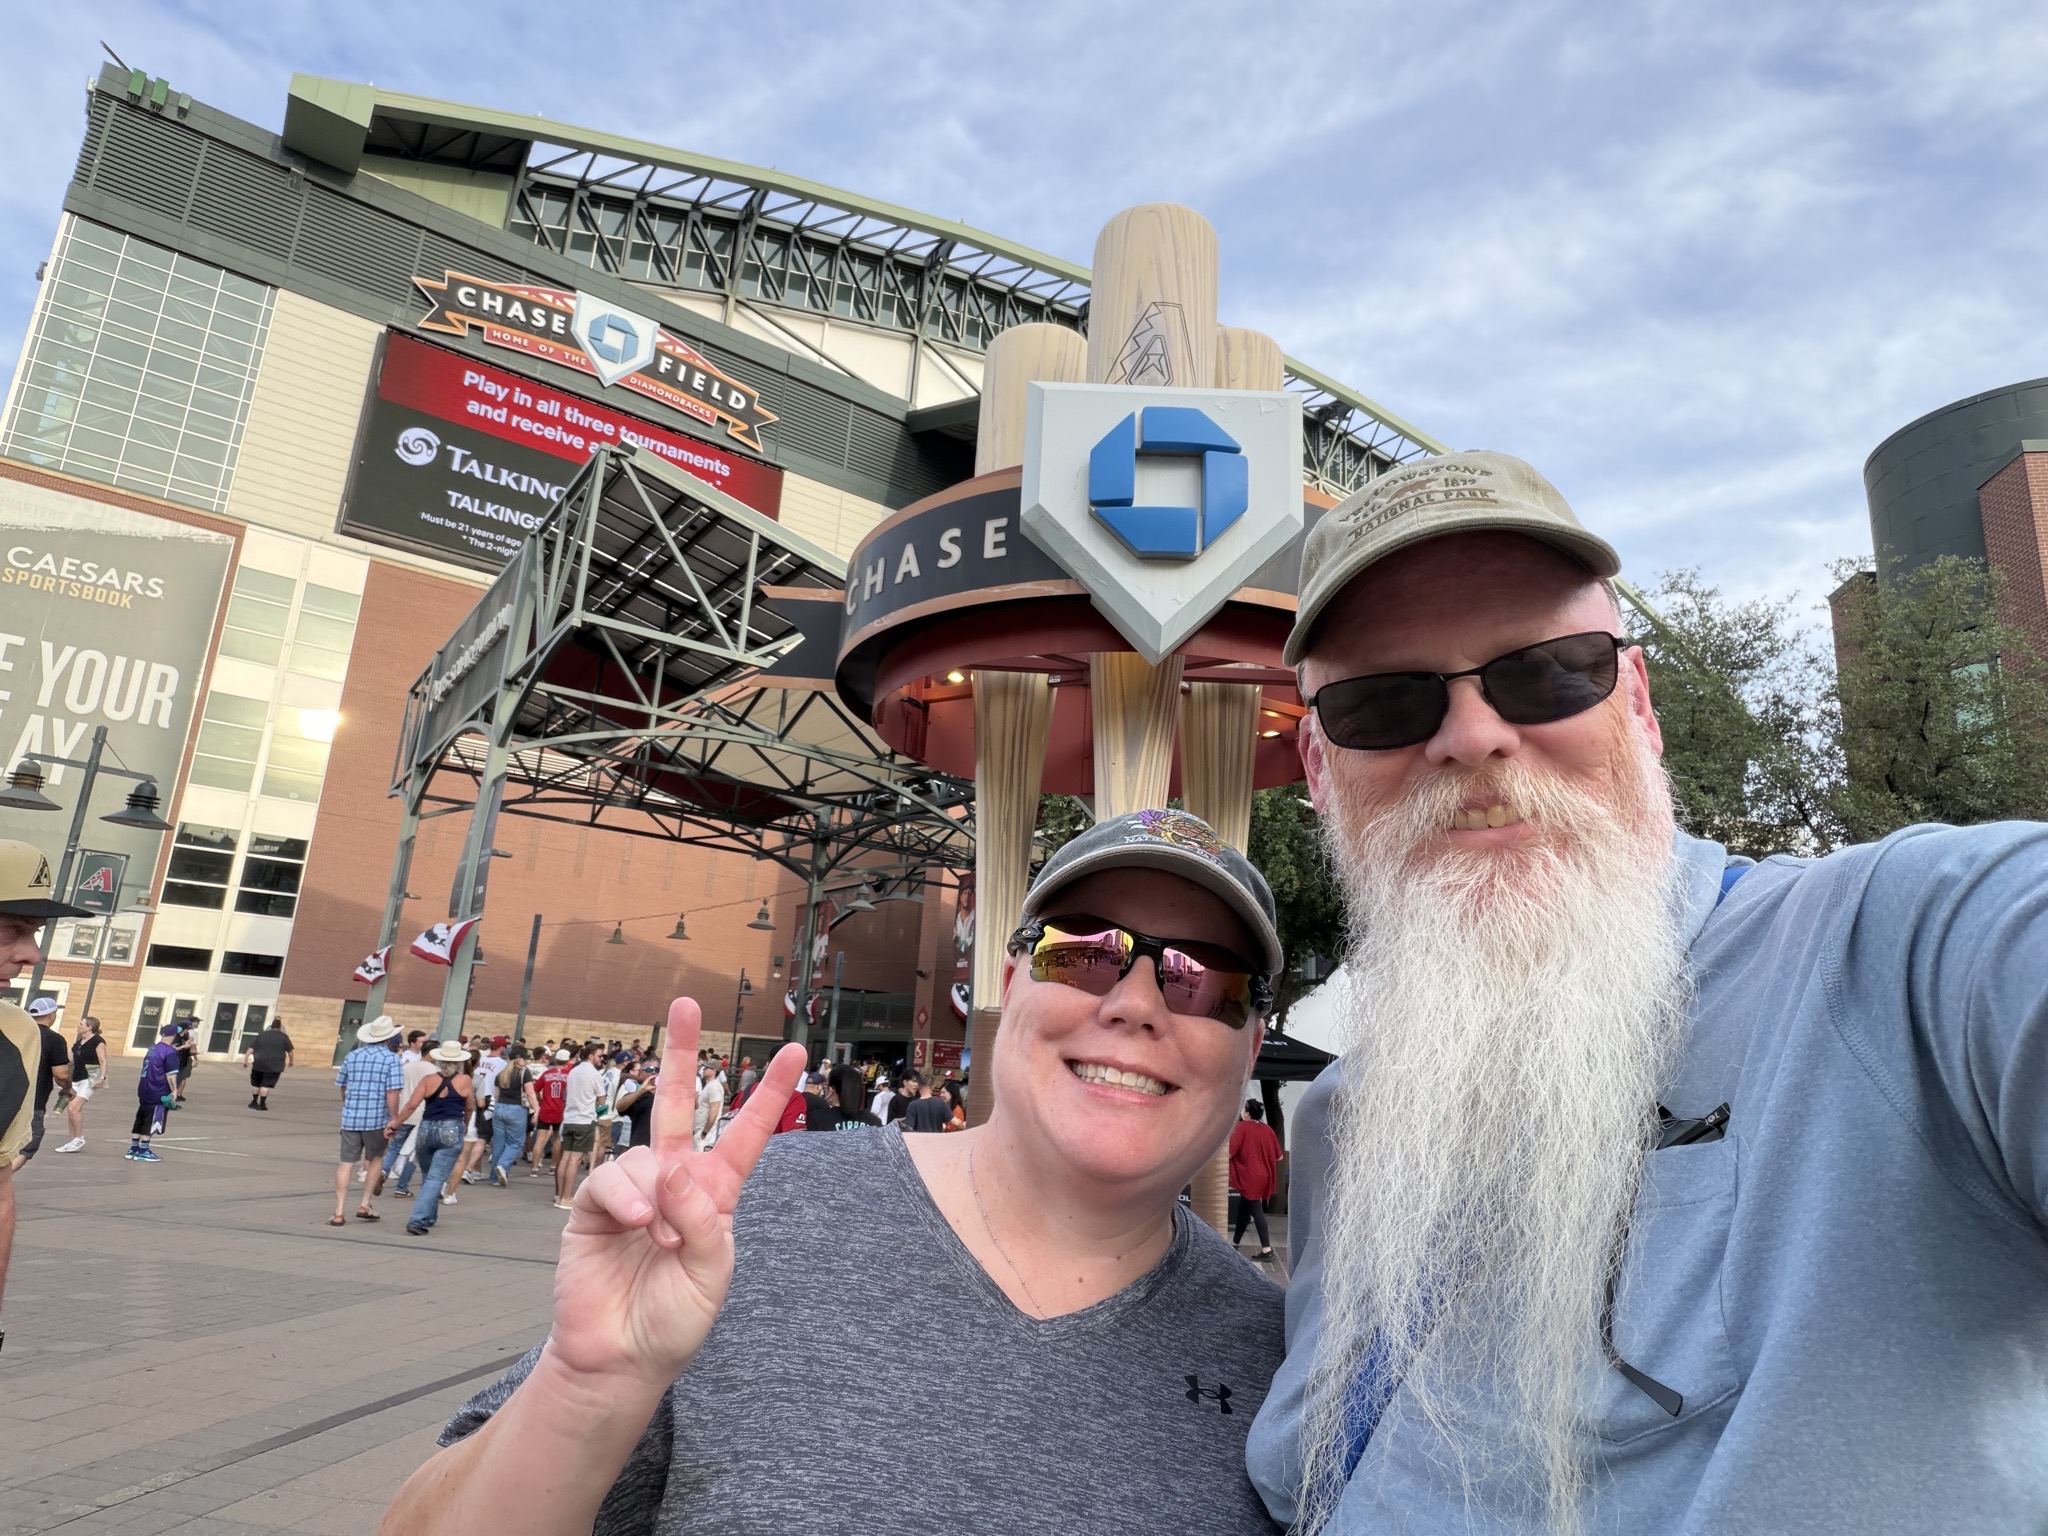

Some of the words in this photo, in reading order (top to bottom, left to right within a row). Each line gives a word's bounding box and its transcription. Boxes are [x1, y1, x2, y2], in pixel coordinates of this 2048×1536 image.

[457, 286, 567, 335] CHASE
[658, 354, 747, 411] FIELD
[493, 330, 529, 348] HOME
[538, 344, 555, 355] OF
[564, 352, 587, 366] THE
[629, 376, 712, 418] DIAMONDBACKS
[463, 370, 510, 402] Play
[513, 386, 532, 408] in
[536, 399, 561, 418] all
[564, 406, 616, 437] three
[619, 426, 731, 477] tournaments
[466, 399, 508, 424] and
[511, 414, 585, 449] receive
[1443, 477, 1477, 488] 1872
[420, 511, 444, 526] Must
[445, 517, 457, 529] be
[457, 522, 469, 533] 21
[471, 526, 495, 540] years
[495, 531, 505, 542] of
[505, 536, 522, 548] age
[1354, 493, 1435, 540] NATIONAL
[1444, 489, 1490, 499] PARK
[468, 536, 485, 549] The
[846, 517, 1009, 616] CHASE
[1, 567, 135, 609] SPORTSBOOK
[6, 546, 165, 599] CAESARS
[36, 640, 180, 729] YOUR
[0, 709, 89, 786] AY
[550, 1081, 562, 1099] 11
